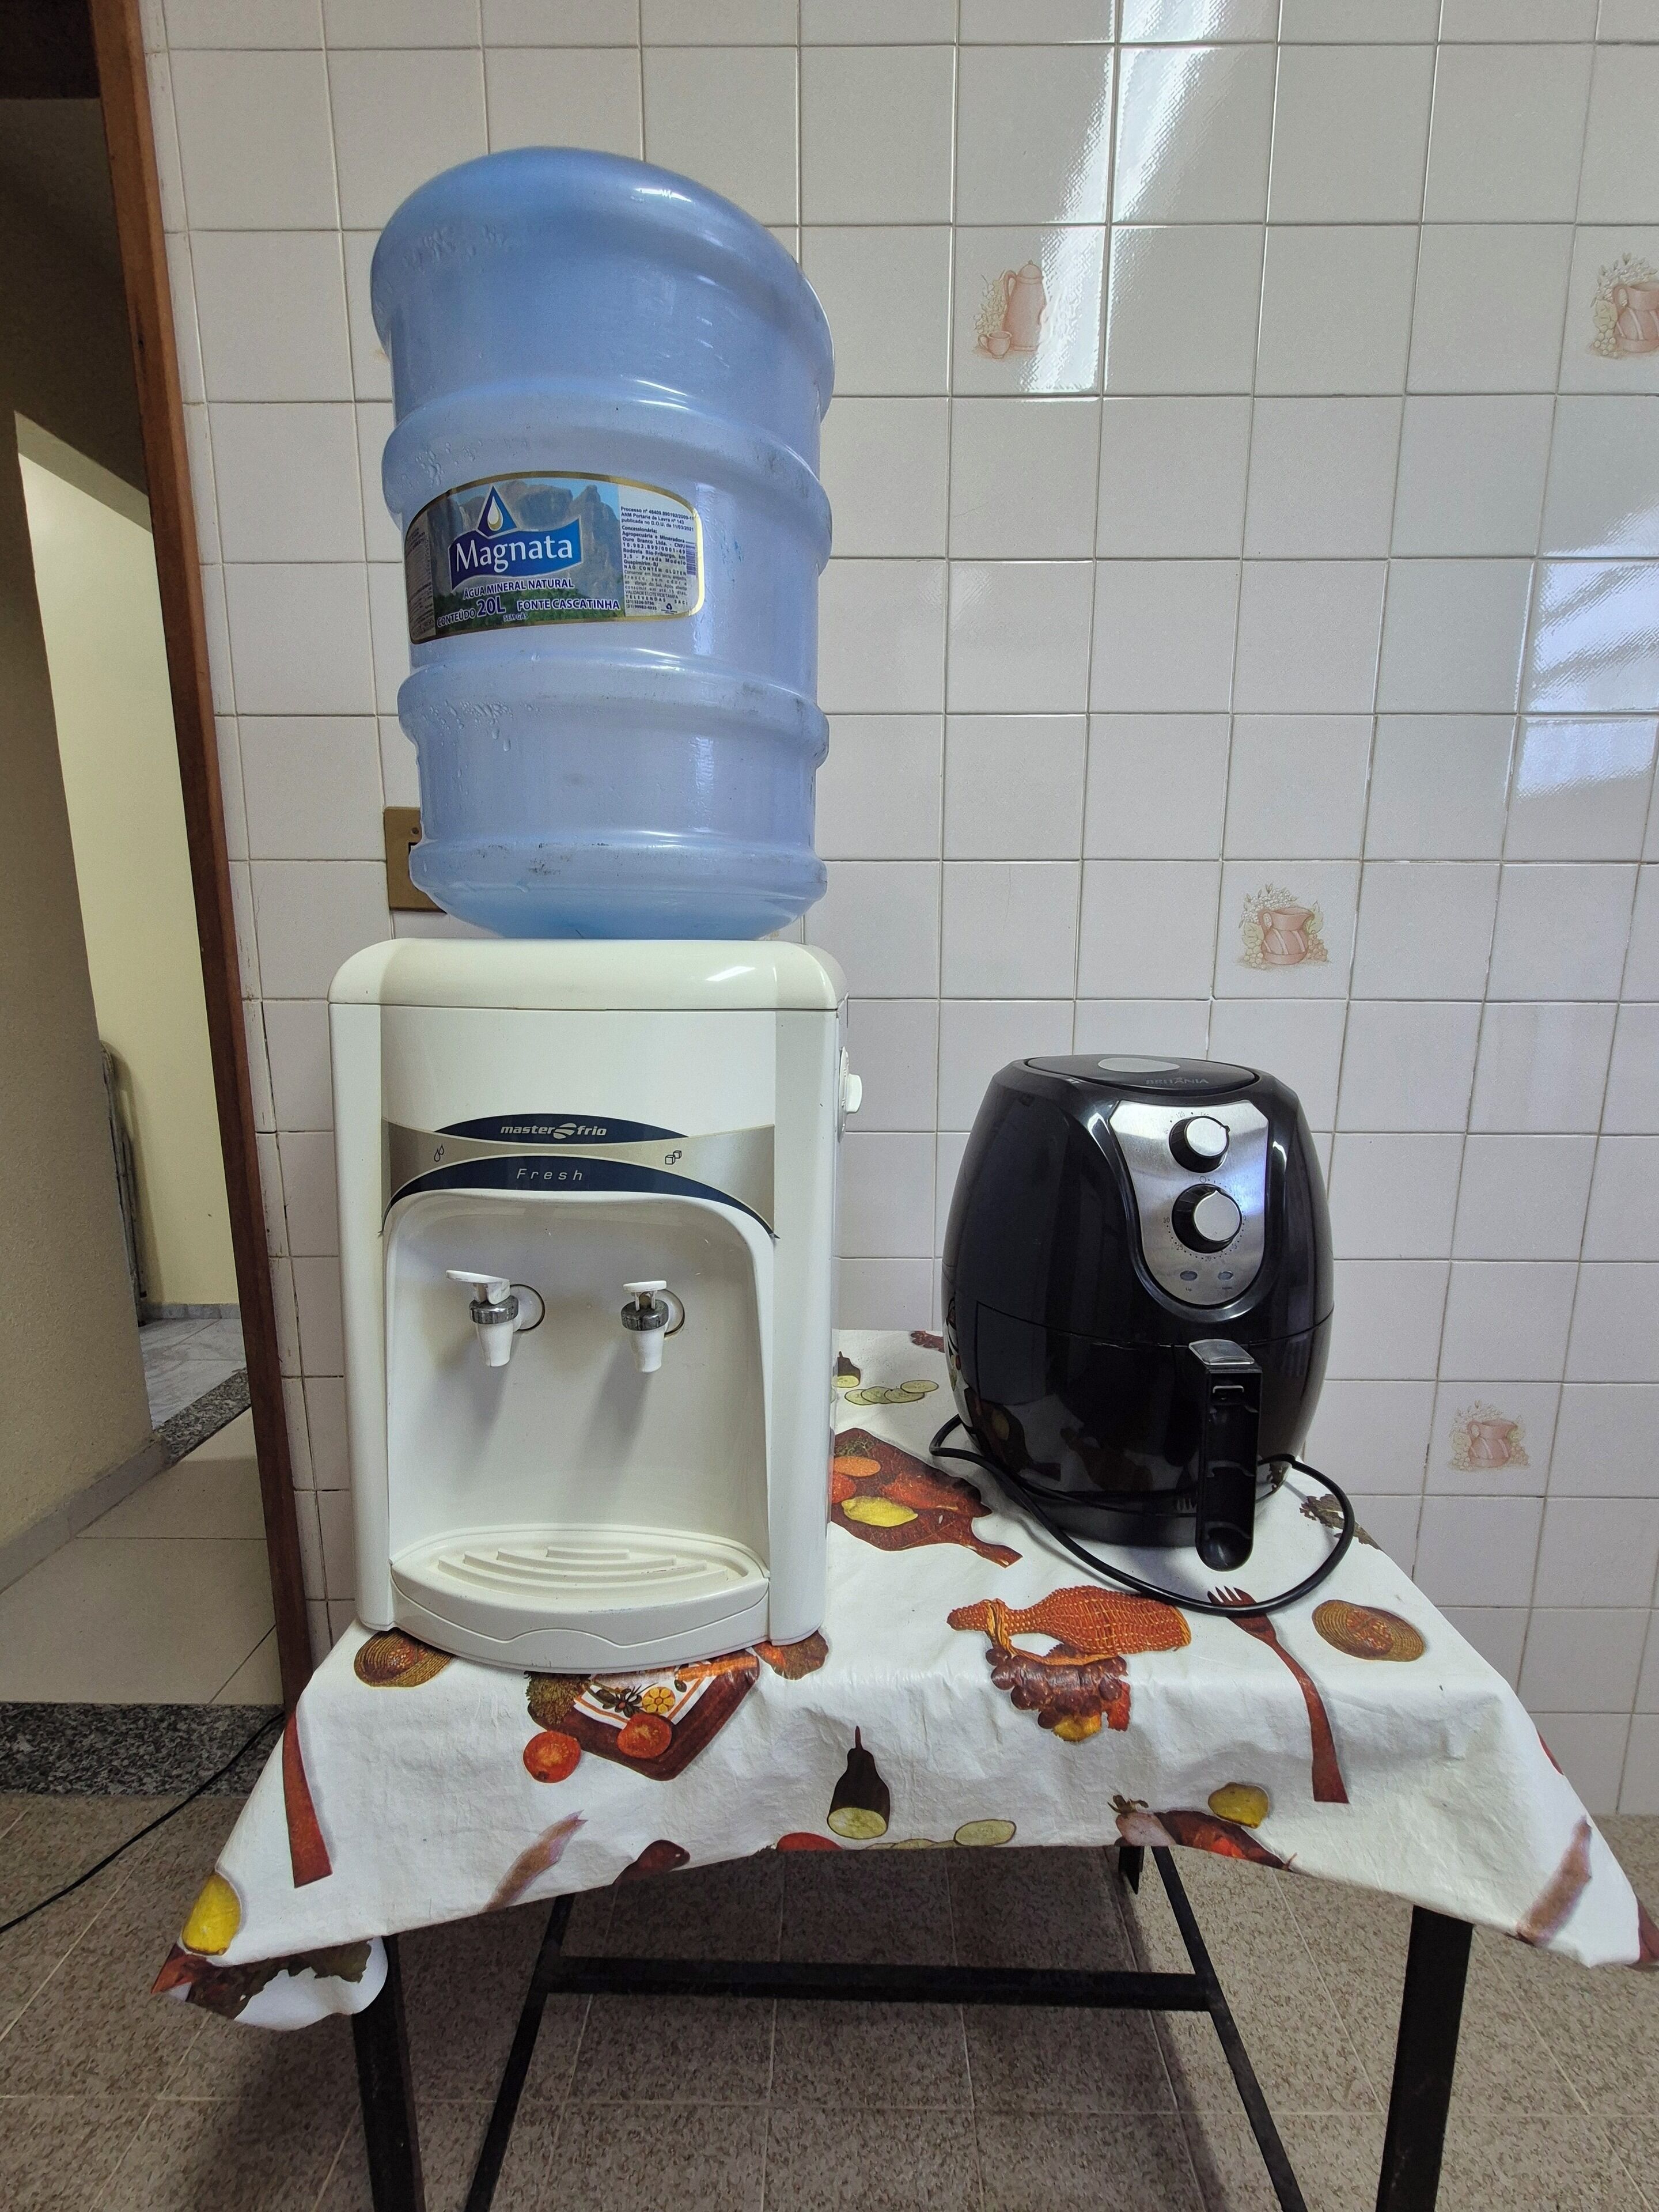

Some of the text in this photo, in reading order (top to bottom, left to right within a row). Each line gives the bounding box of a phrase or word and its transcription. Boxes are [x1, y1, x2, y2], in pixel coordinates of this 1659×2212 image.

[622, 525, 657, 533] Concessionária:
[456, 536, 573, 573] Magnata
[463, 579, 574, 600] ÁGUA MINERAL NATURAL
[626, 594, 666, 603] TELEVENDAS
[518, 599, 620, 611] FONTE CASCATINHA
[437, 596, 505, 627] CONTEÚDO 20L
[516, 612, 528, 621] GÁS
[501, 1125, 607, 1136] master frio
[516, 1168, 583, 1181] Fresh
